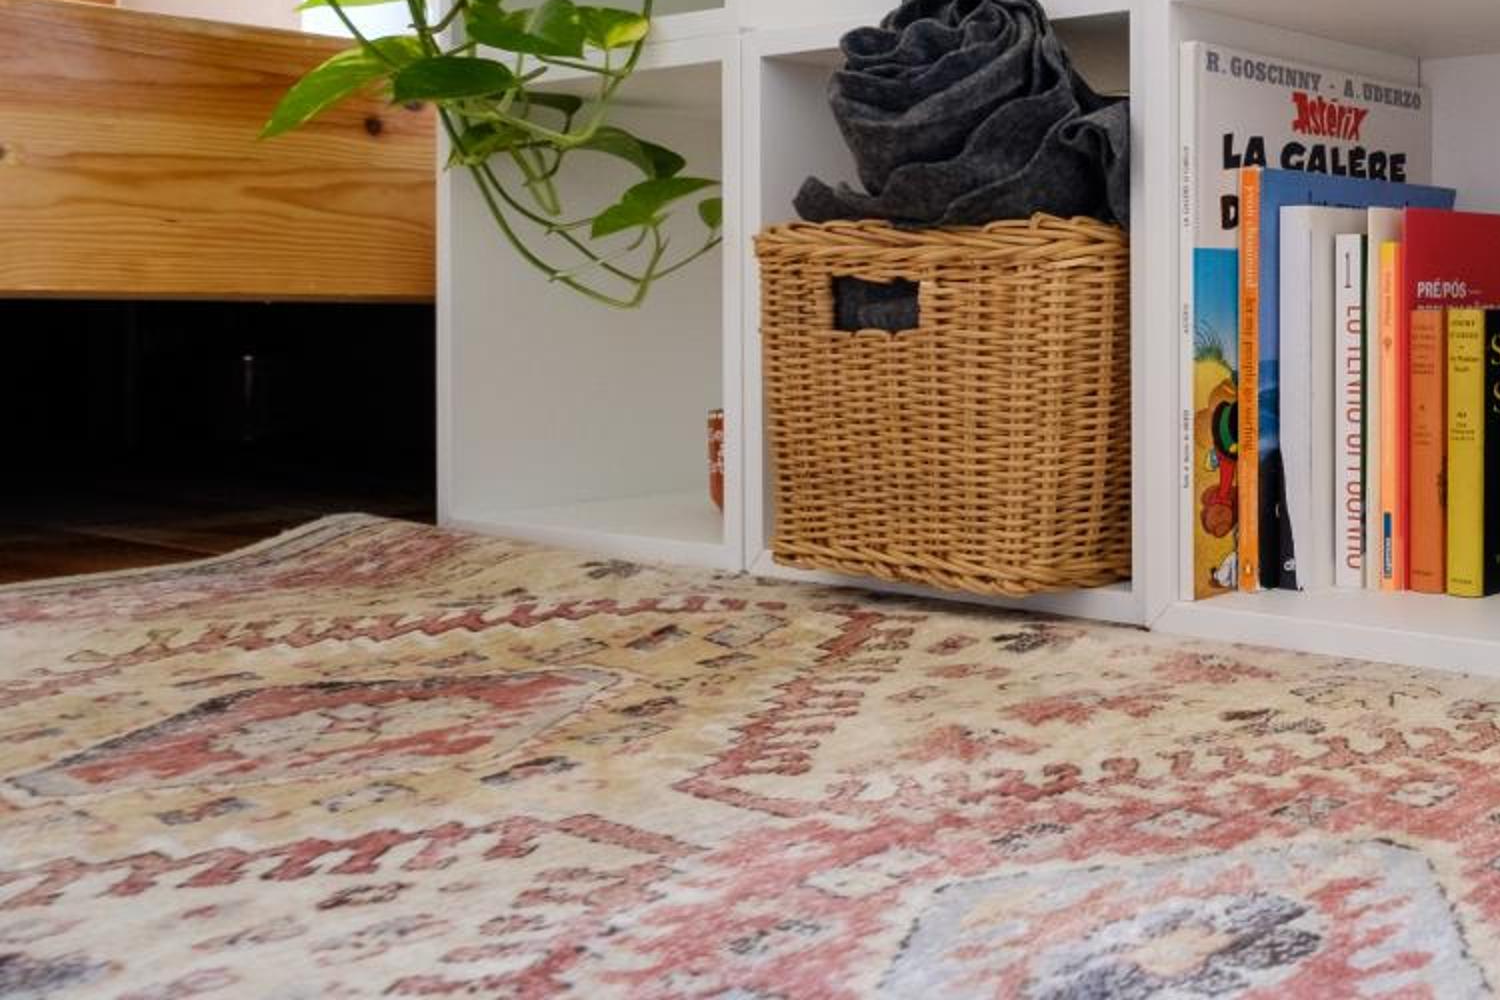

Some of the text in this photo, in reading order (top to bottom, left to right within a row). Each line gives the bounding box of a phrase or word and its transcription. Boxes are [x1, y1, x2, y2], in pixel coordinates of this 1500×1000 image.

[1230, 56, 1322, 93] GOSCINNY
[1362, 82, 1422, 110] UDERZO
[1222, 133, 1267, 170] LA
